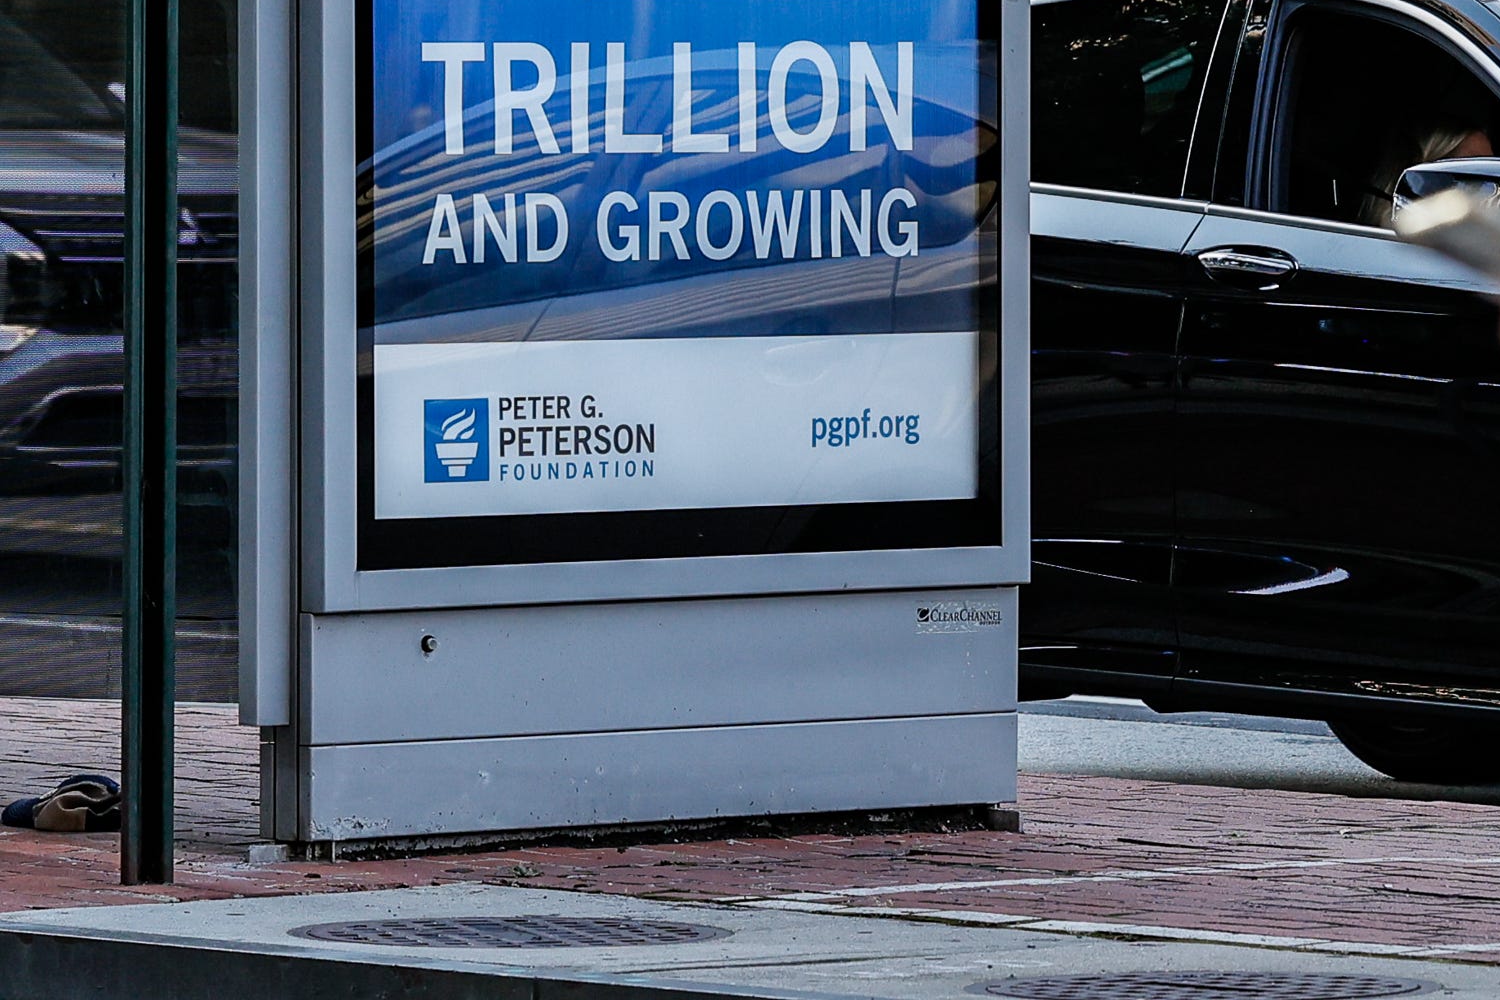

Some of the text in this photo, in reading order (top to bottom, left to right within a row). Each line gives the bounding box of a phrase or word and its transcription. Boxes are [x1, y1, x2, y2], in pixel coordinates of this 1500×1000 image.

[421, 40, 914, 155] TRILLION
[422, 187, 919, 265] AND GROWING
[499, 395, 603, 421] PETER G.
[499, 423, 655, 458] PETERSON
[812, 407, 920, 448] pgpf.org
[499, 459, 655, 482] FOUNDATION
